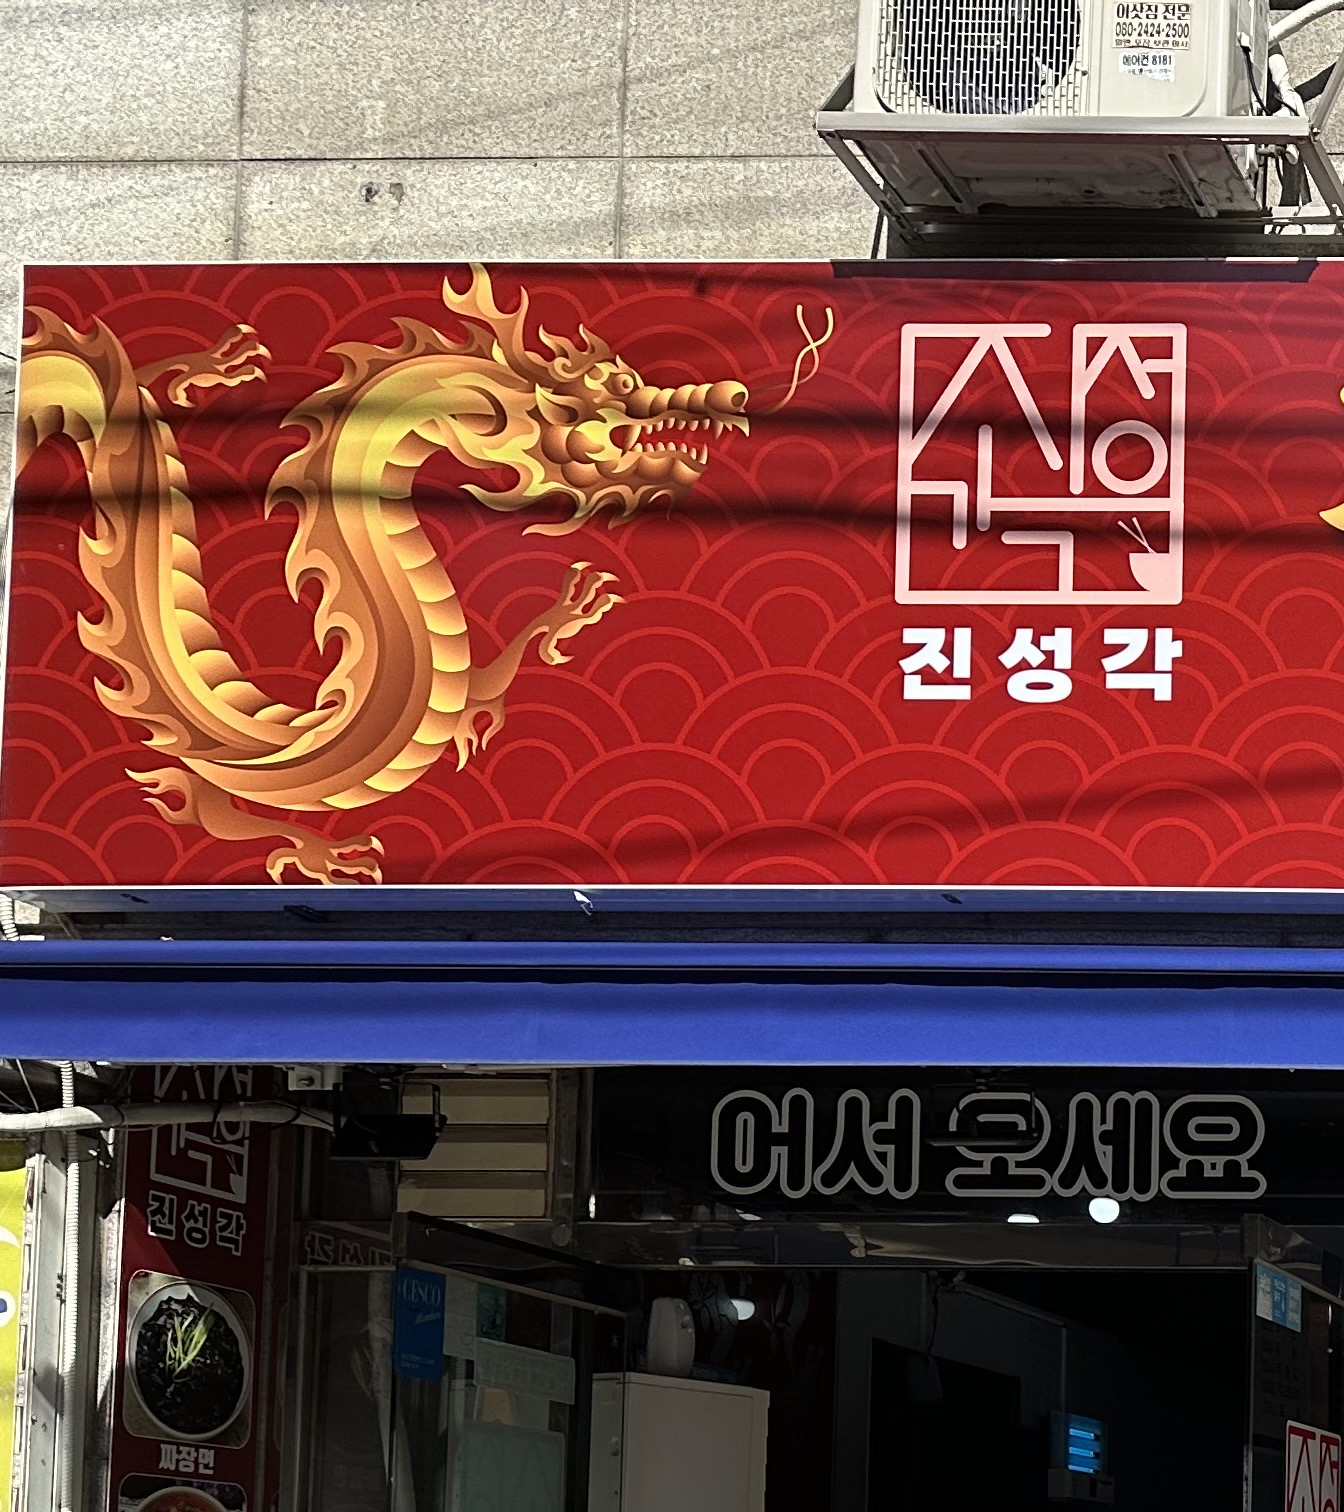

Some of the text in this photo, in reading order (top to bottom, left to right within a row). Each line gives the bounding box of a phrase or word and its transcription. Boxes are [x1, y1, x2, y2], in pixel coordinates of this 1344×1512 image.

[1116, 3, 1191, 21] 이삿짐 전문
[898, 627, 1183, 703] 진성각
[710, 1088, 1267, 1201] 어서 오세요
[147, 1190, 246, 1257] 진성각
[158, 1444, 215, 1476] 짜장면
